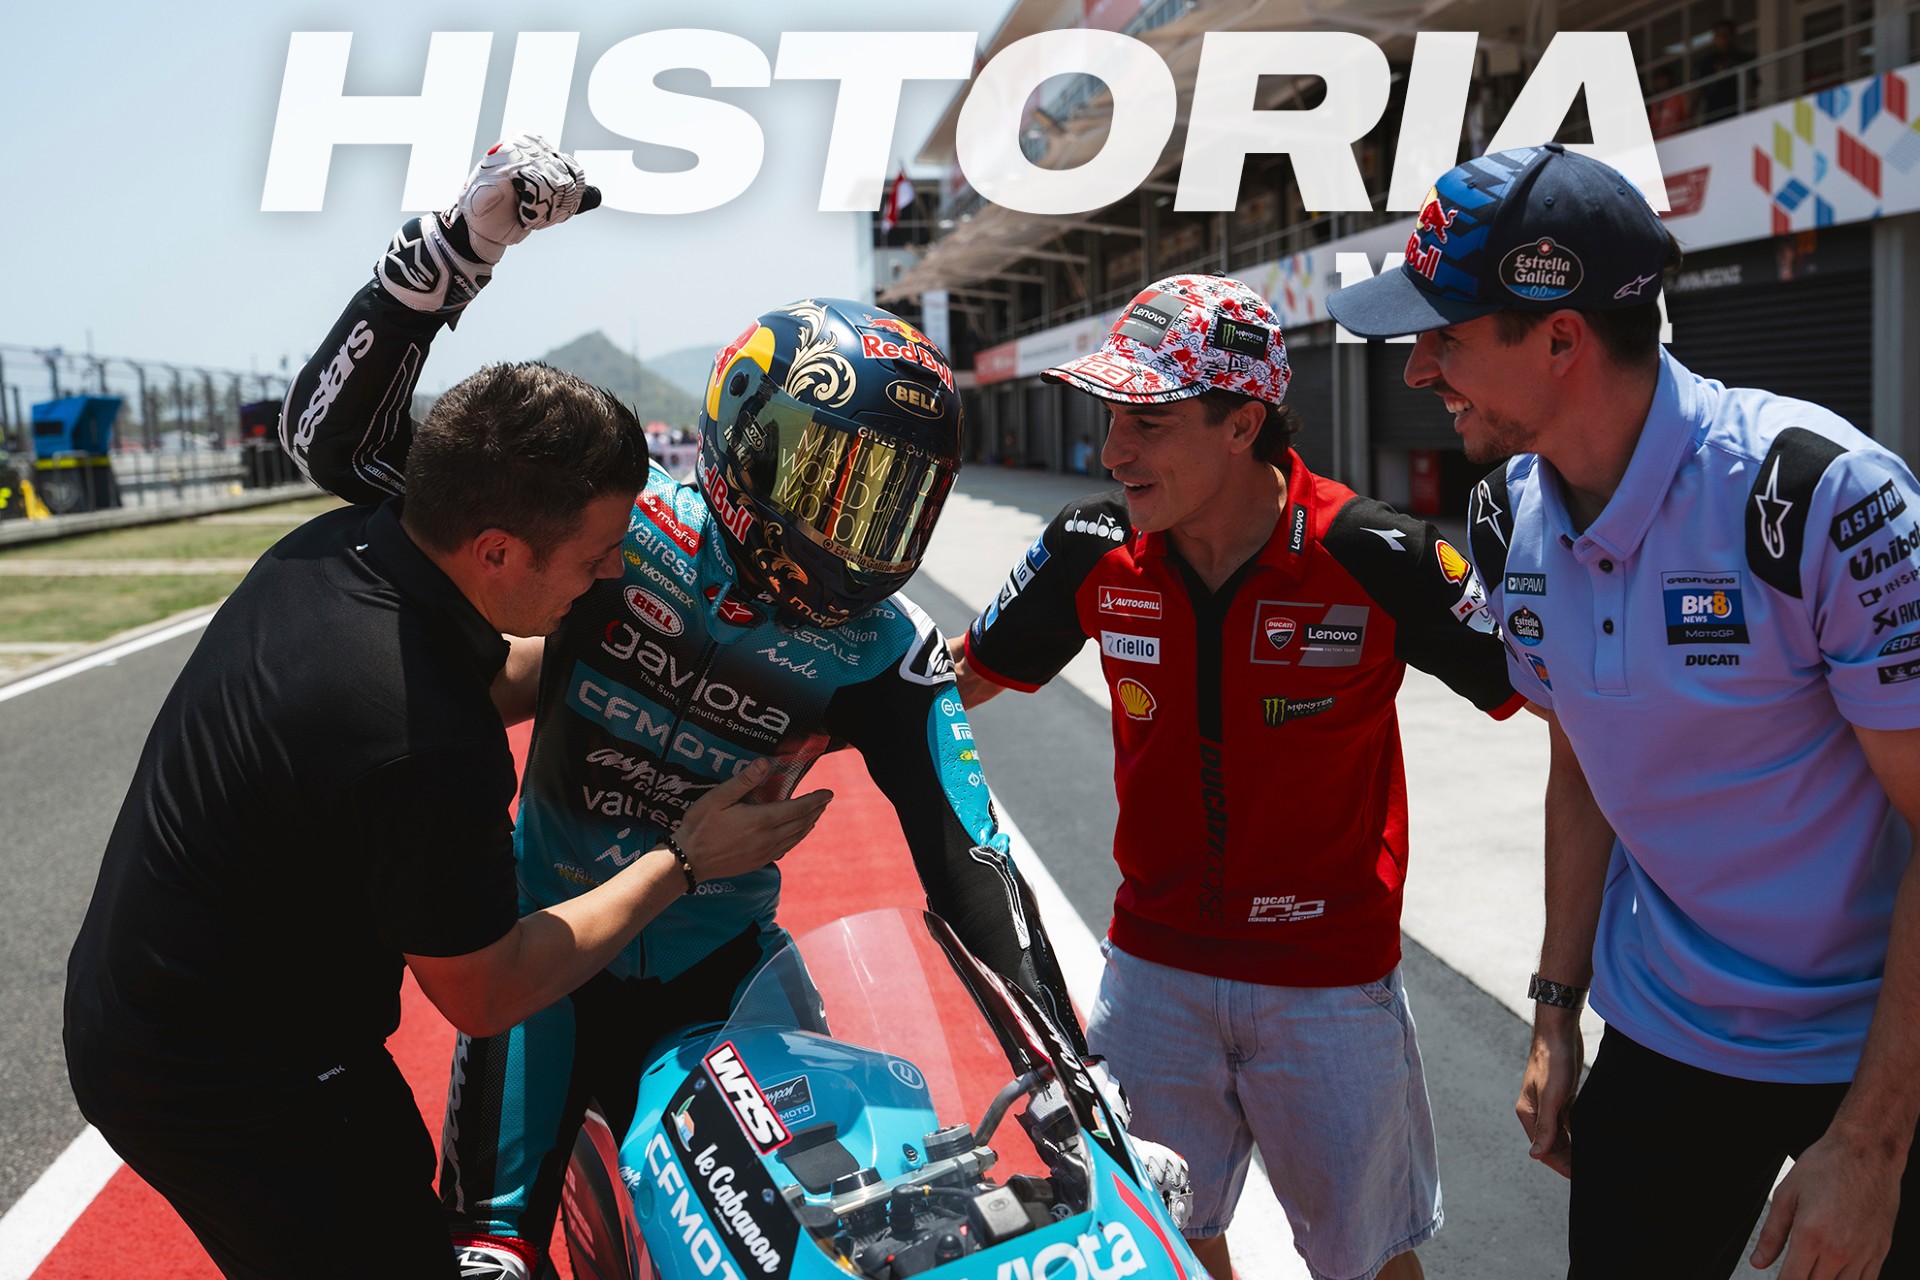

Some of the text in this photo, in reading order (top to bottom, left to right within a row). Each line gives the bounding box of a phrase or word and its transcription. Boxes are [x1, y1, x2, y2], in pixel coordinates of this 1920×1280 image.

[1514, 254, 1570, 271] Estrella
[1514, 268, 1566, 286] Galicia
[1131, 304, 1167, 326] Lenovo
[861, 334, 918, 365] Red
[917, 345, 954, 394] Bull
[895, 384, 939, 415] BELL
[858, 426, 897, 448] GIVES
[782, 448, 870, 510] WORLD
[712, 474, 754, 545] Bull
[1839, 485, 1902, 542] ASPIRA
[657, 511, 697, 548] mapfre
[1064, 509, 1126, 542] diadora
[1291, 509, 1305, 551] Lenovo
[627, 515, 698, 586] valresa
[711, 522, 734, 576] CFMOTO
[640, 561, 696, 609] MOTOREX
[1515, 576, 1544, 592] NPAW
[632, 592, 674, 632] BELL
[789, 596, 849, 628] map
[862, 607, 896, 619] OTO
[1115, 598, 1160, 611] AUTOGRILL
[1681, 591, 1728, 615] BK8
[1514, 616, 1539, 628] Estrella
[1516, 625, 1540, 637] Galicia
[1683, 615, 1708, 623] NEWS
[1685, 629, 1735, 638] MotoGP
[1116, 637, 1155, 657] riello
[1308, 628, 1358, 641] Lenovo
[1685, 654, 1740, 666] DUCATI
[601, 620, 791, 735] gaviota
[640, 670, 657, 688] The
[656, 684, 676, 701] Sun
[725, 719, 778, 744] Specialists
[1287, 697, 1333, 711] MONSTER
[583, 785, 682, 832] valres
[1200, 744, 1228, 855] DUCATI
[1253, 895, 1296, 905] DUCATI
[708, 1046, 787, 1144] WRS
[764, 1078, 804, 1106] spar
[778, 1104, 811, 1121] MOTO
[694, 1142, 719, 1176] le
[708, 1166, 781, 1273] Cabanon
